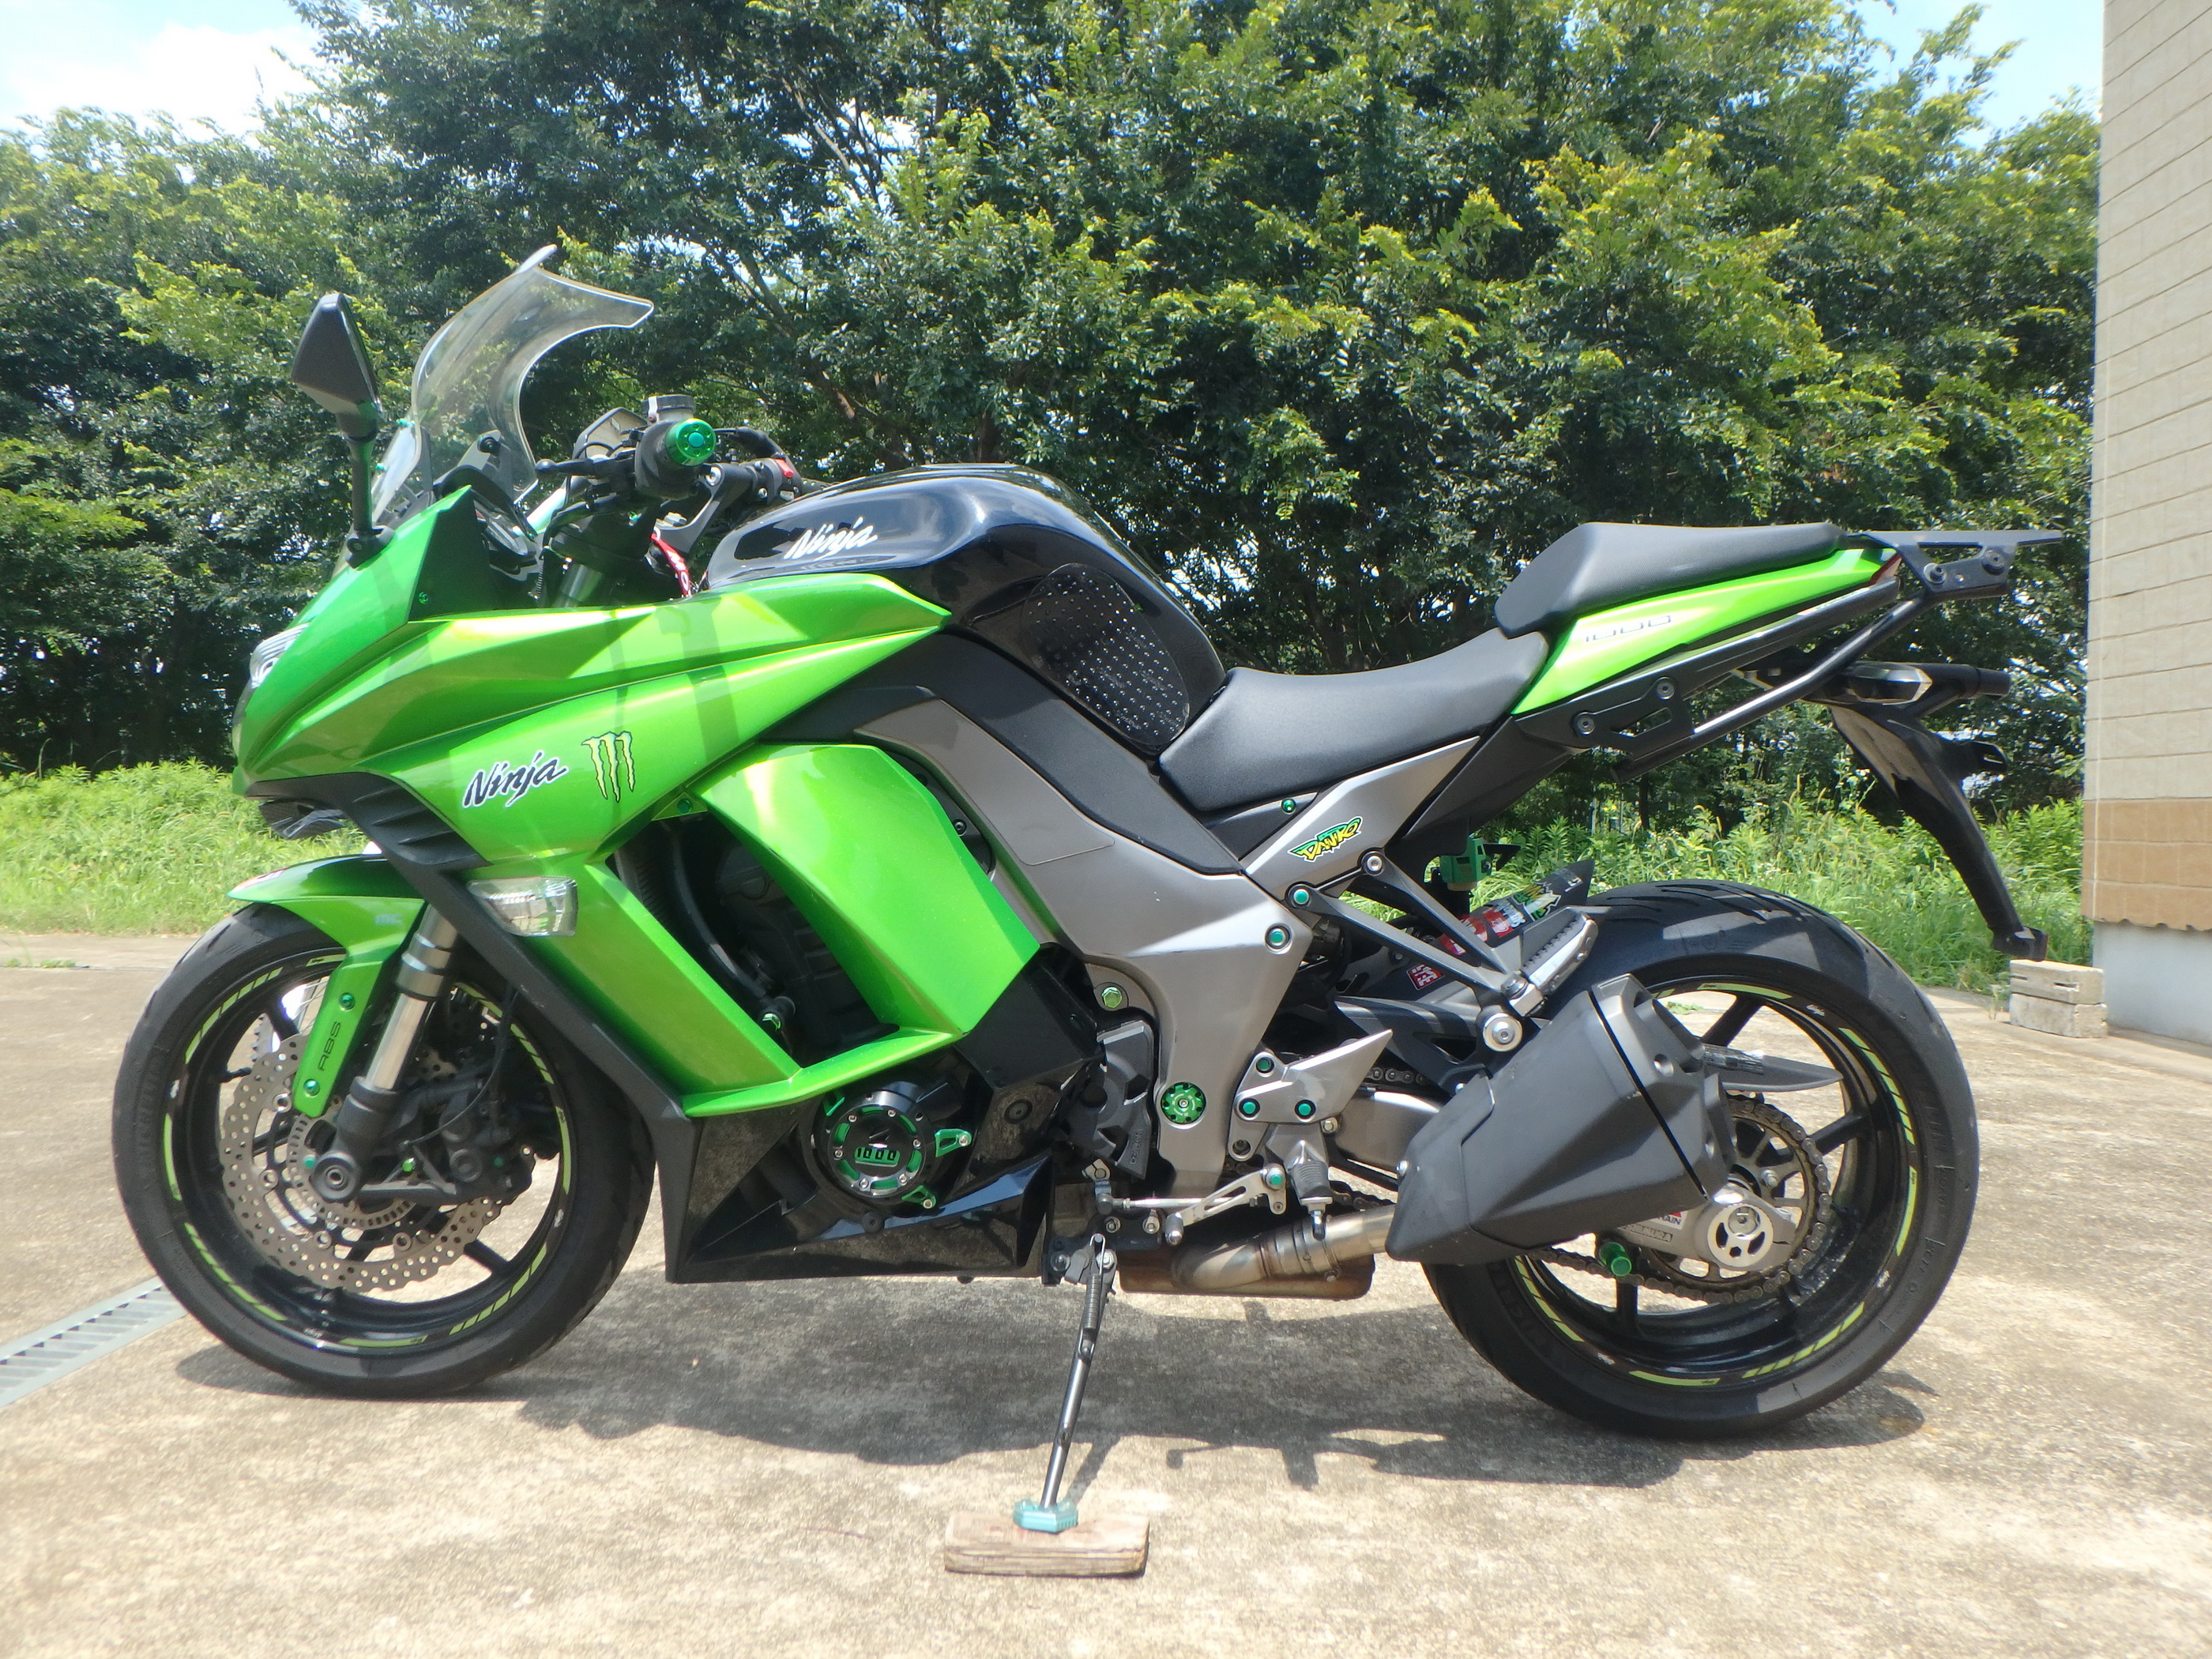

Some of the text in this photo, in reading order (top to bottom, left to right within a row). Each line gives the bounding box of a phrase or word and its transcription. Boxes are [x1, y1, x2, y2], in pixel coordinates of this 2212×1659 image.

[783, 516, 878, 562] Ninja
[463, 750, 568, 807] Ninja
[318, 1021, 341, 1070] ABS
[856, 1146, 897, 1161] 1000
